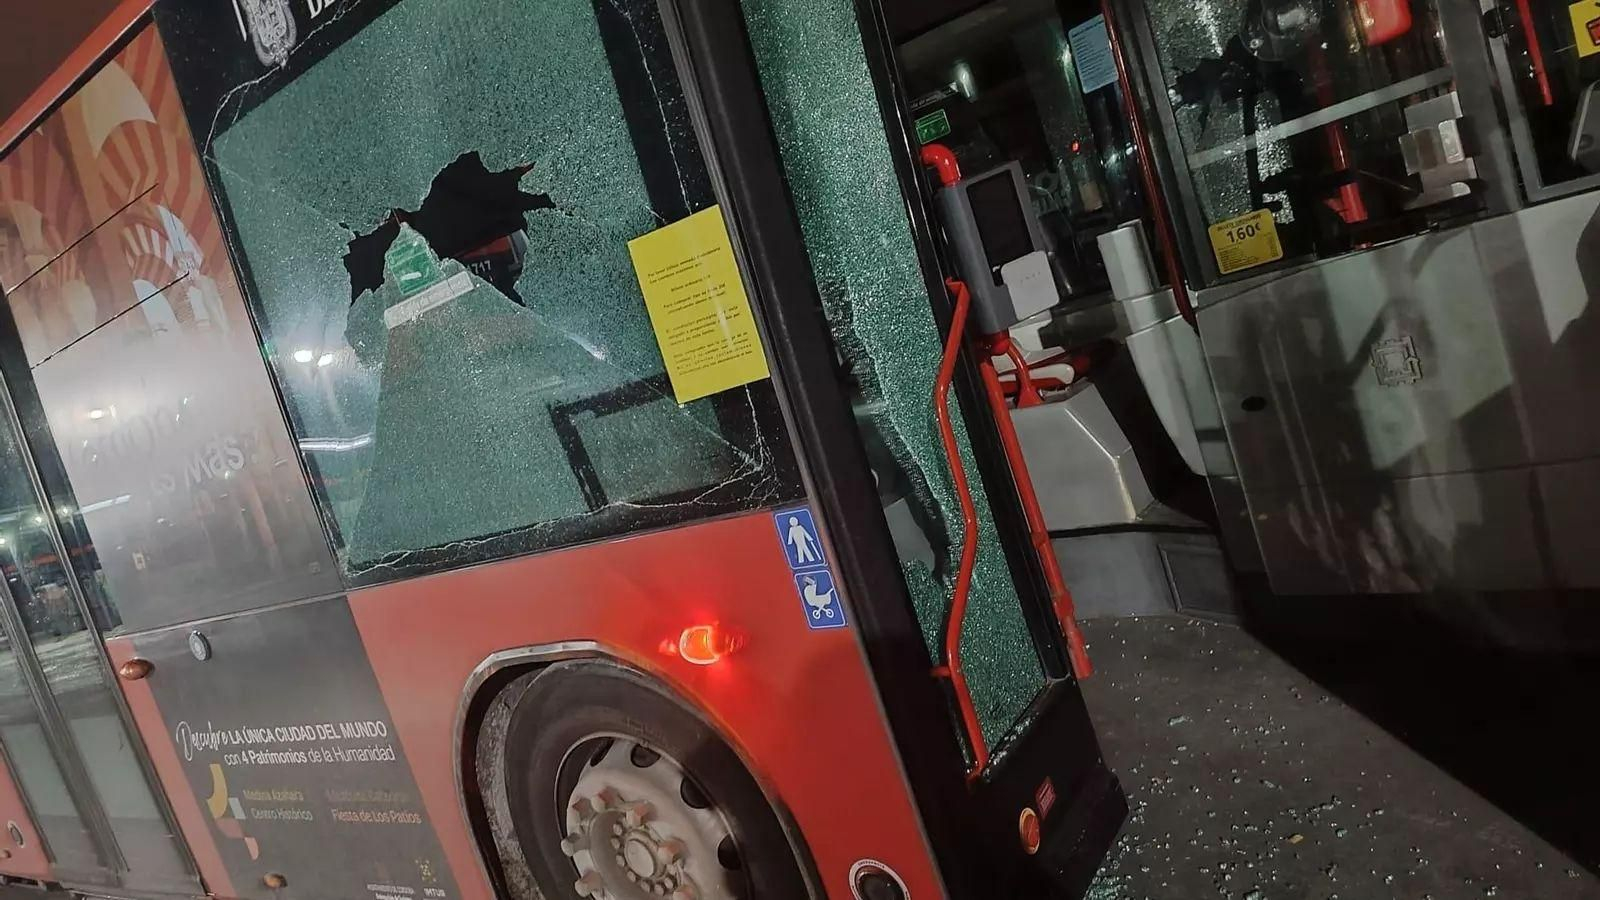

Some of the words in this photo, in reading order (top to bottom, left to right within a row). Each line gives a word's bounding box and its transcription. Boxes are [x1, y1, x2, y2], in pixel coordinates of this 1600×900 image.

[176, 720, 228, 761] Descubre
[227, 729, 245, 744] LA
[242, 725, 275, 744] ÚNICA
[274, 724, 317, 742] CIUDAD
[315, 723, 341, 740] DEL
[340, 720, 388, 739] MUNDO
[224, 753, 241, 766] con
[241, 750, 250, 764] 4
[248, 747, 308, 765] Patrimonios
[307, 747, 322, 762] de
[320, 746, 334, 762] la
[332, 744, 395, 762] Humanidad
[359, 809, 373, 823] de
[371, 811, 391, 824] Los
[389, 810, 422, 824] Patios
